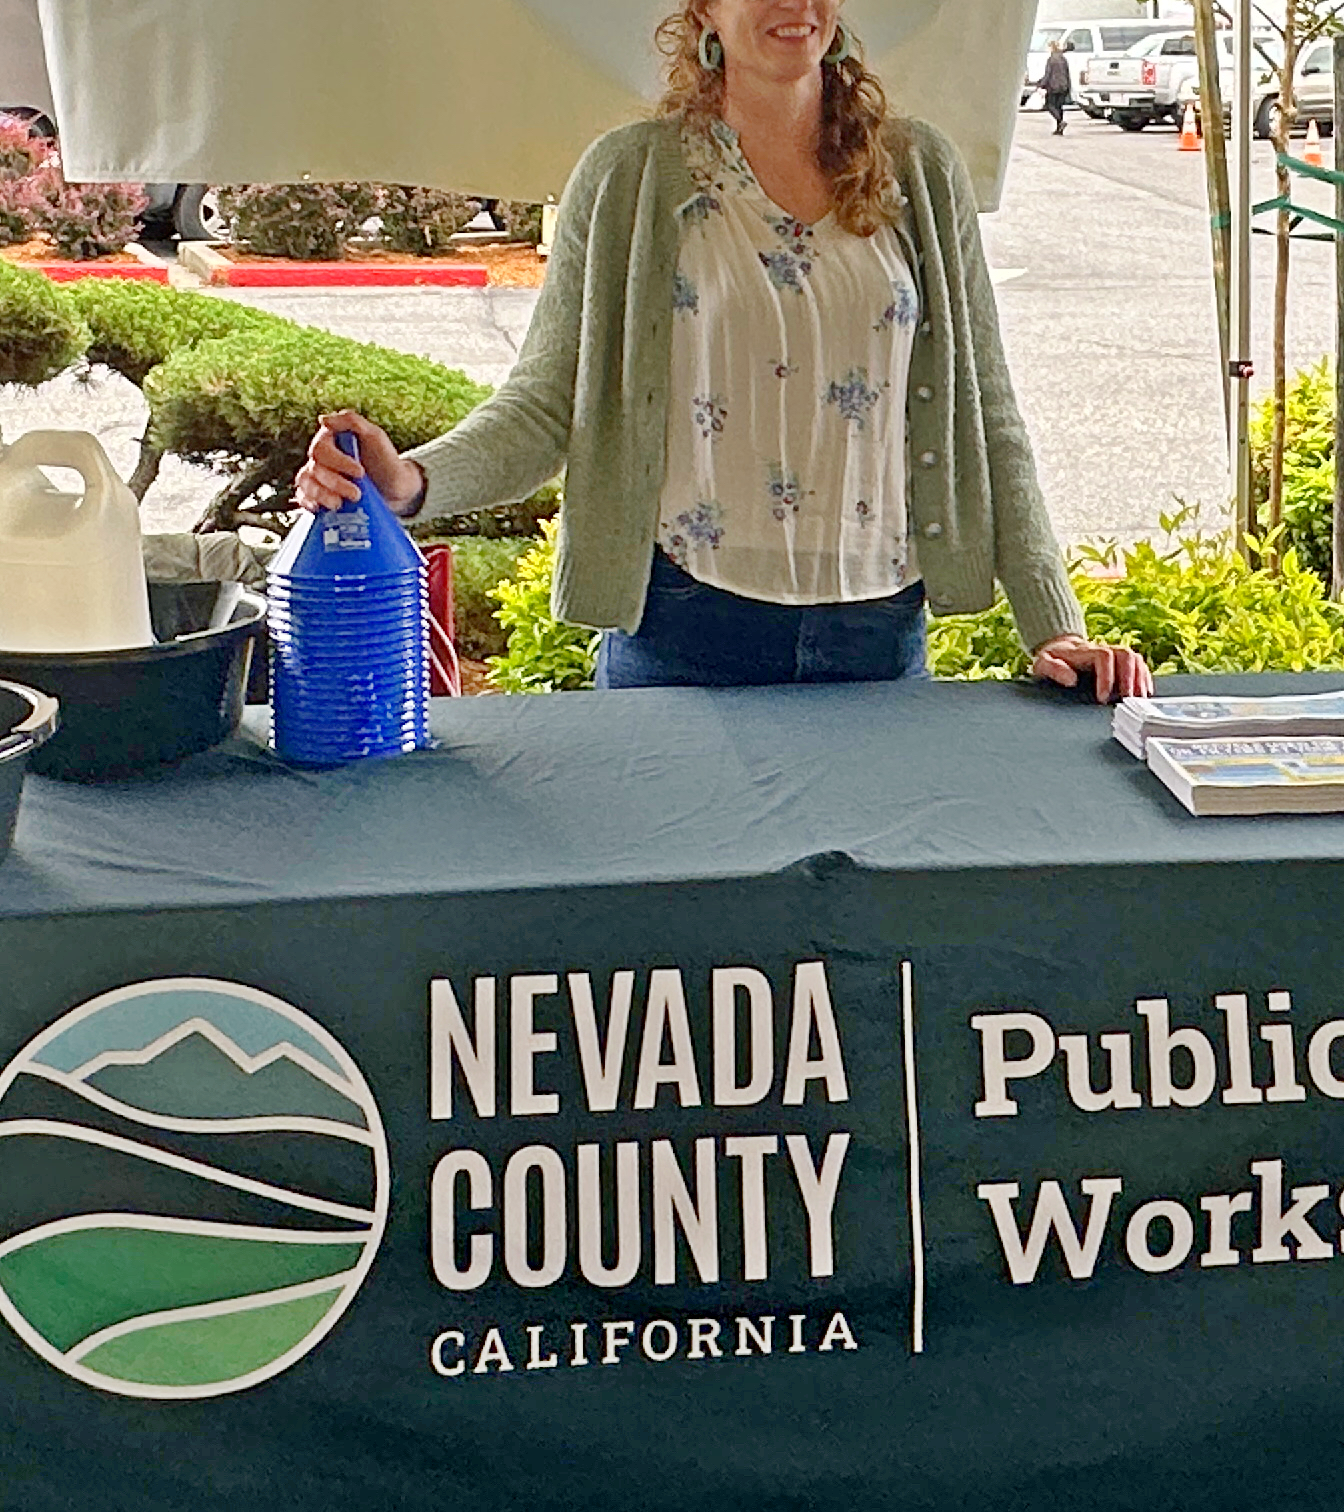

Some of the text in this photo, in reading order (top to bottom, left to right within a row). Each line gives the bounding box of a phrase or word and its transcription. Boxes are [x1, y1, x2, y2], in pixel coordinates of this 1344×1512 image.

[430, 961, 848, 1120] NEVADA
[431, 1133, 850, 1291] COUNTY
[431, 1313, 858, 1376] CALIFORNIA
